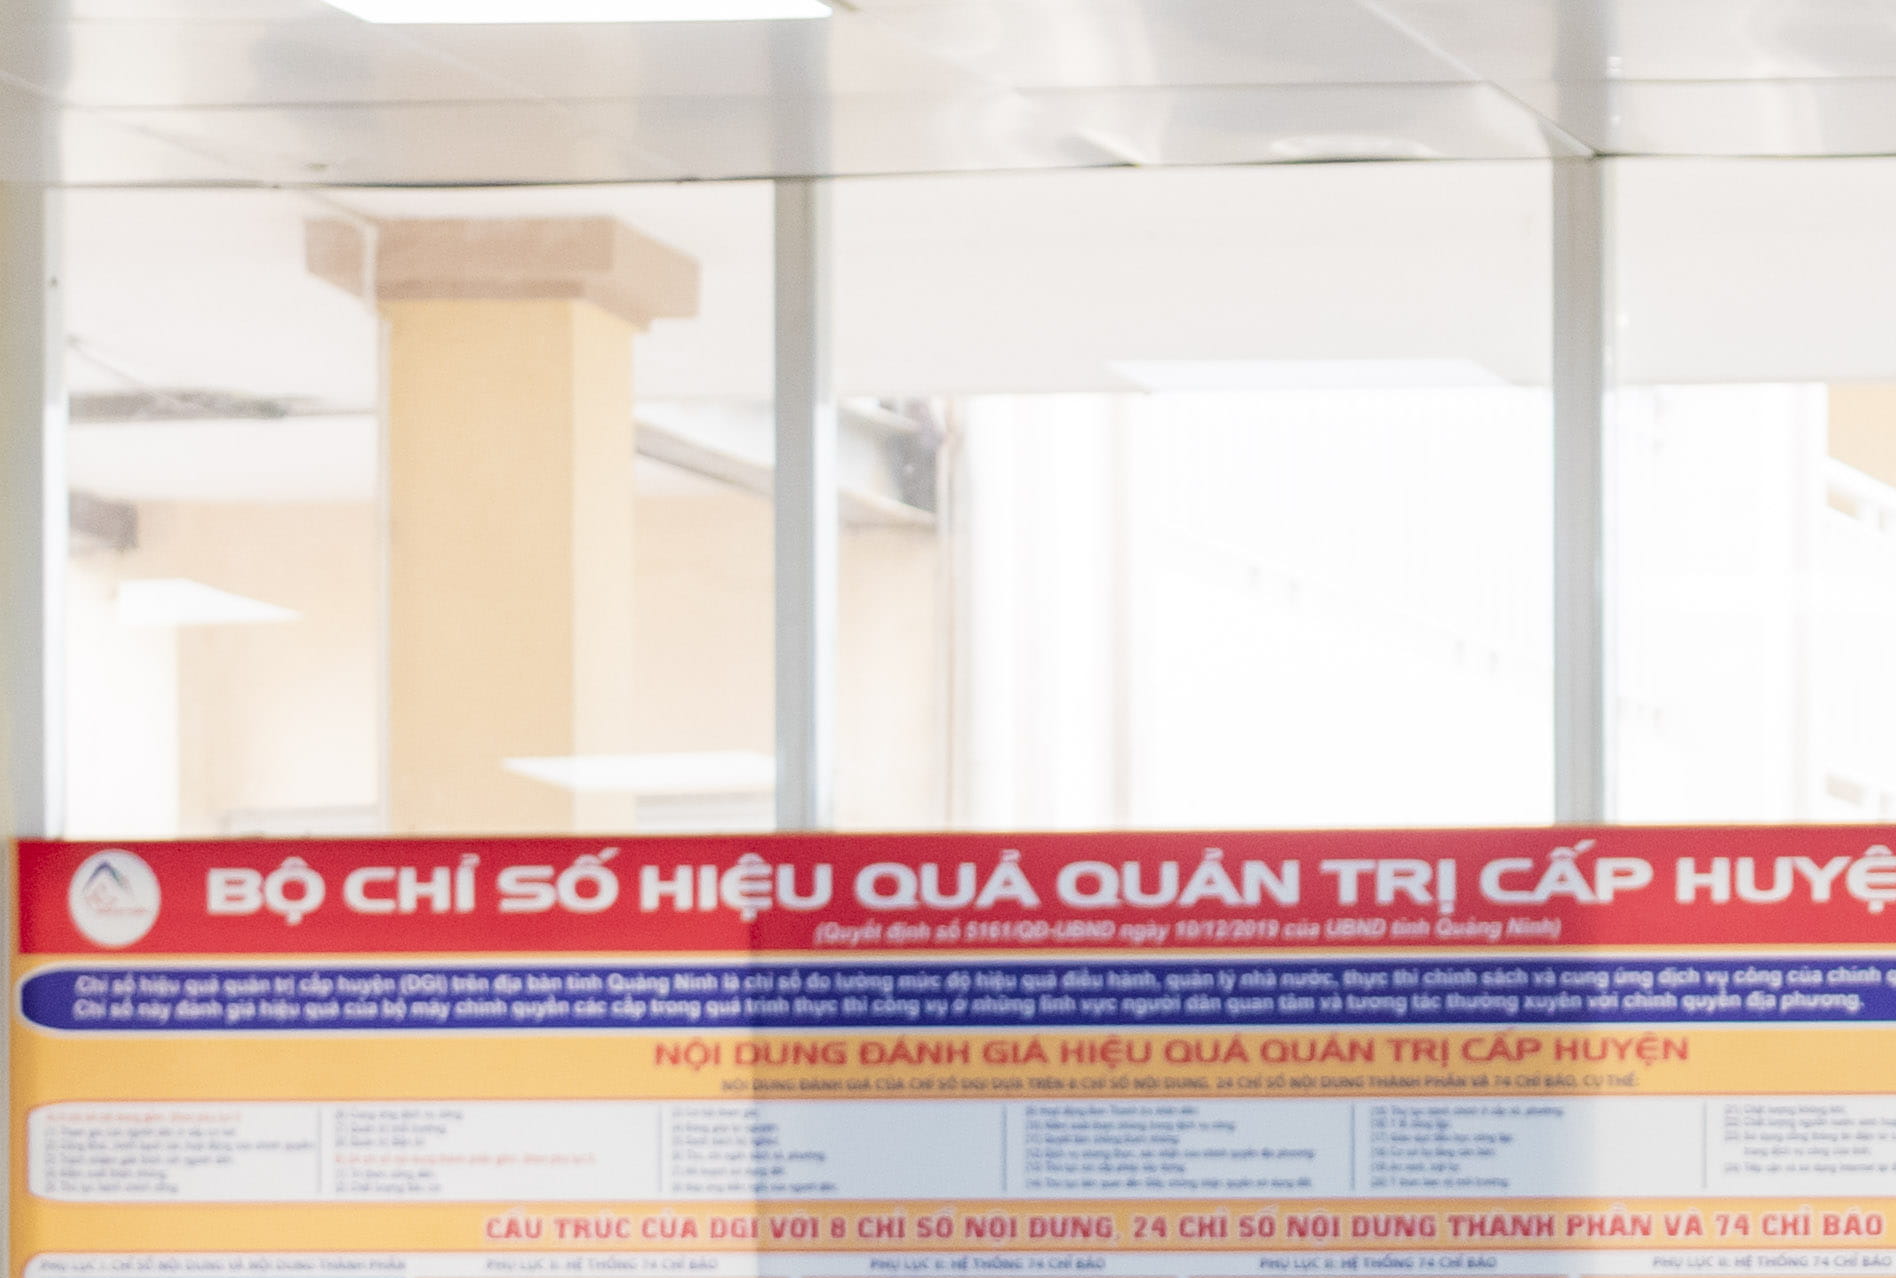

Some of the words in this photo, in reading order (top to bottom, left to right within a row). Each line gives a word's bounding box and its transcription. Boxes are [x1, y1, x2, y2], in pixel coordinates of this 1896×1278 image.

[207, 857, 326, 924] BỘ
[344, 854, 481, 914] CHỈ
[496, 847, 622, 914] SỐ
[640, 853, 834, 922] HIỆU
[855, 849, 1039, 911] QUẢ
[1057, 847, 1300, 910] QUẢN
[1319, 857, 1456, 914] TRỊ
[1478, 838, 1655, 906] CẤP
[1559, 971, 1608, 992] cung
[1614, 968, 1653, 992] ứng
[1657, 968, 1699, 991] dịch
[1705, 971, 1728, 991] vụ
[1733, 967, 1782, 991] công
[1786, 967, 1822, 988] của
[1826, 967, 1882, 988] chính
[655, 1037, 720, 1070] NỘI
[735, 1042, 847, 1067] DUNG
[859, 1036, 969, 1066] ĐÁNH
[982, 1034, 1048, 1065] GIÁ
[1060, 1034, 1152, 1068] HIỆU
[1164, 1034, 1250, 1064] QUẢ
[1260, 1033, 1375, 1063] QUẢN
[1387, 1037, 1450, 1068] TRỊ
[1461, 1027, 1542, 1062] CẤP
[1553, 1033, 1690, 1067] HUYỆN
[709, 1217, 760, 1239] DGI
[830, 1216, 847, 1238] 8
[857, 1207, 906, 1238] CHỈ
[916, 1207, 957, 1238] SỐ
[964, 1211, 1018, 1244] NỘI
[1029, 1216, 1119, 1243] DUNG,
[1133, 1216, 1167, 1238] 24
[1179, 1207, 1229, 1238] CHỈ
[1239, 1207, 1280, 1238] SỐ
[1286, 1211, 1341, 1244] NỘI
[1351, 1216, 1437, 1238] DUNG
[1565, 1206, 1652, 1237] PHẦN
[1716, 1215, 1749, 1237] 74
[1762, 1206, 1811, 1237] CHỈ
